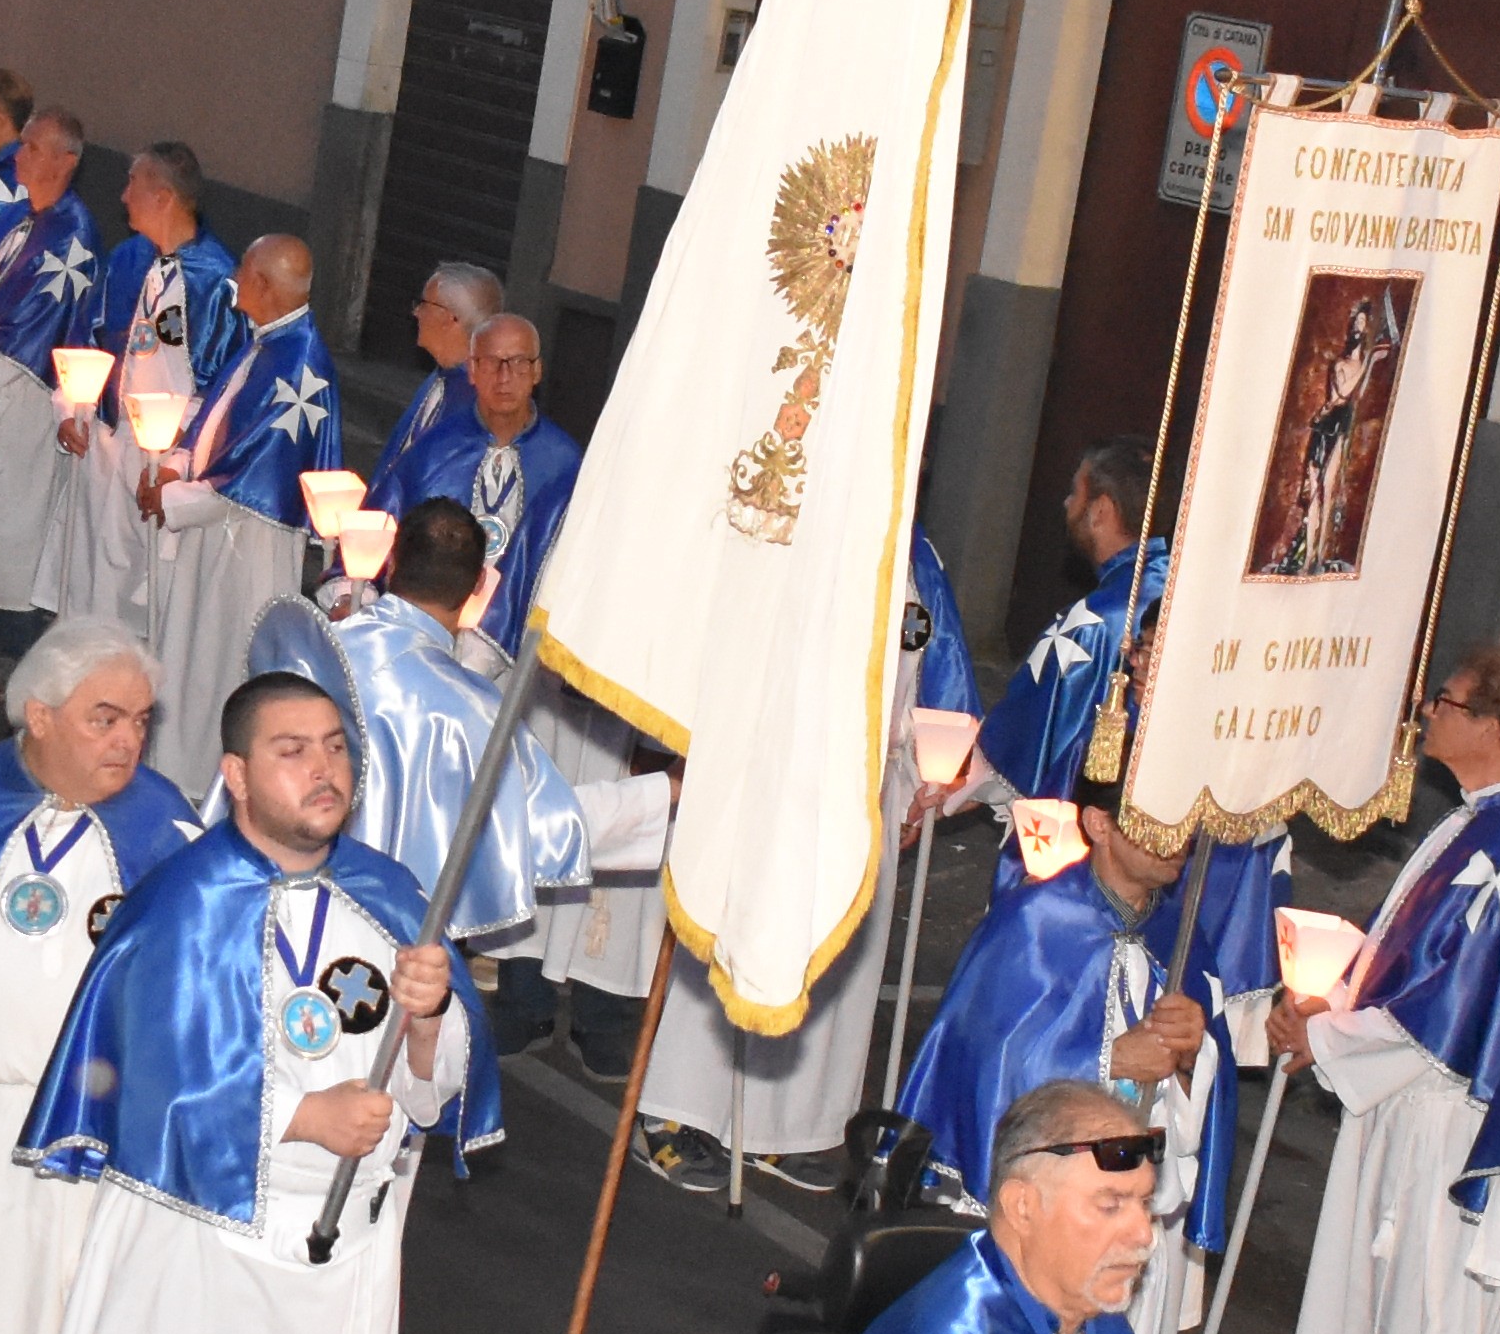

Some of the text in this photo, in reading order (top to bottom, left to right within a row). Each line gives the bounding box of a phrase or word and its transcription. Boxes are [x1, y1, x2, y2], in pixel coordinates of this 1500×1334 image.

[1224, 29, 1258, 46] CATANIA
[1184, 140, 1226, 160] paso
[1169, 159, 1234, 185] carraile
[1263, 205, 1483, 256] SAN GIOVANNI BATTISTA
[1213, 705, 1321, 740] GALERMO
